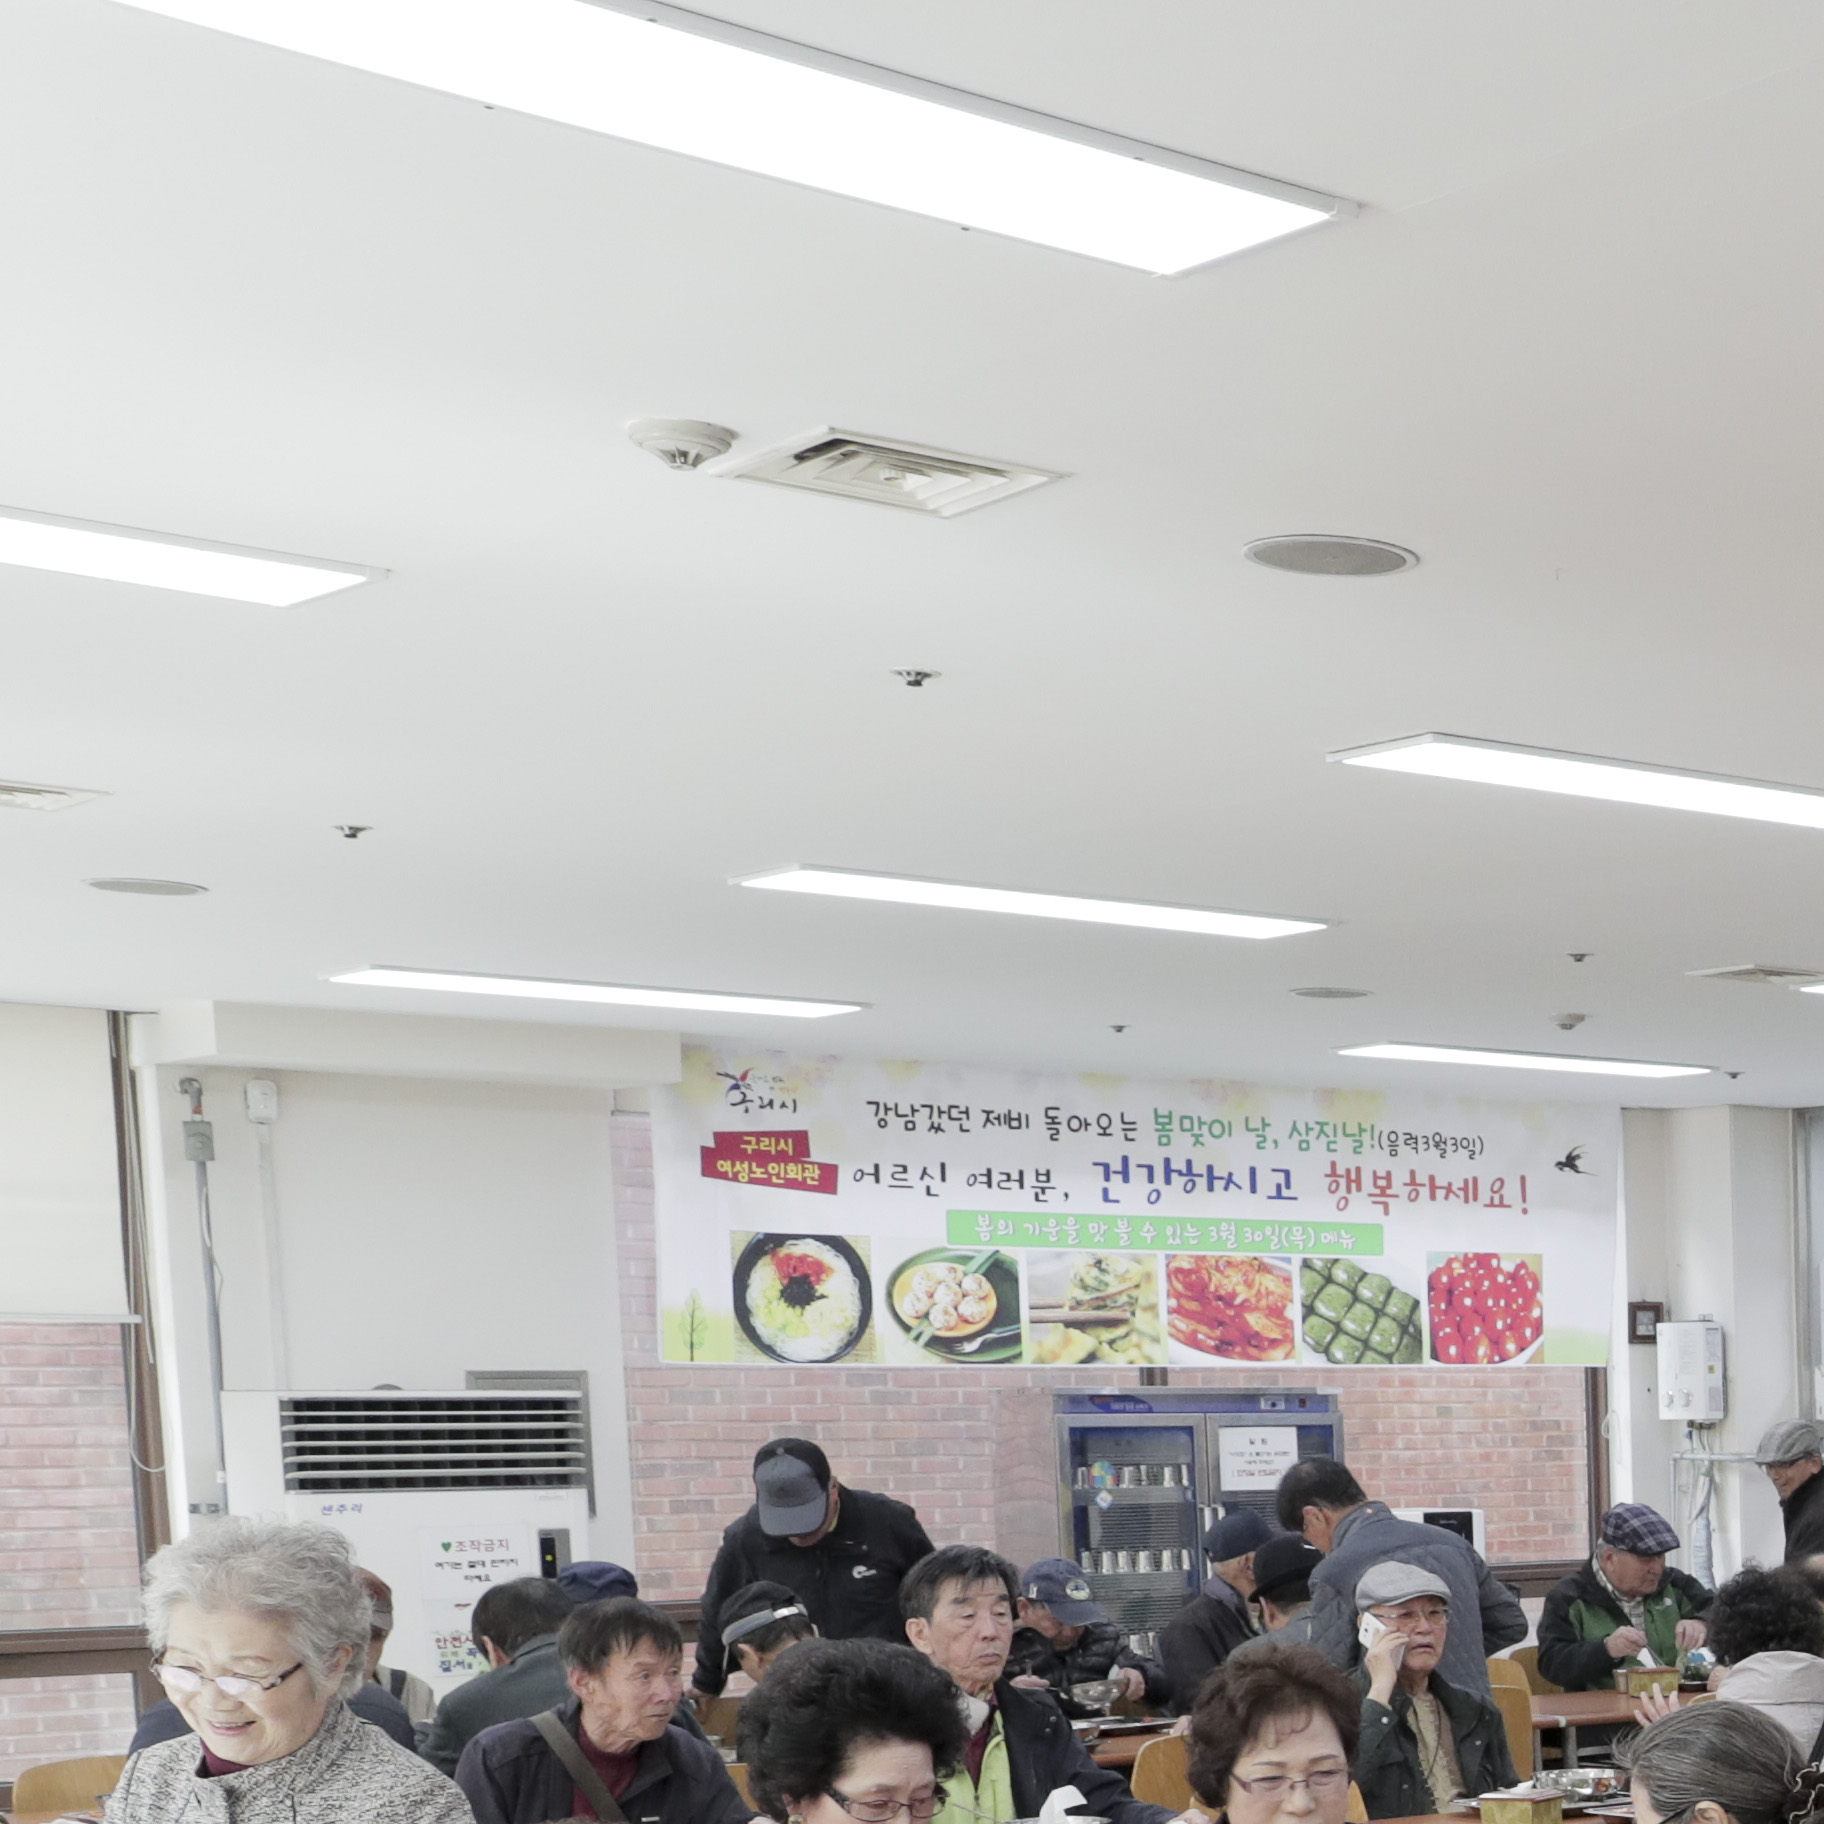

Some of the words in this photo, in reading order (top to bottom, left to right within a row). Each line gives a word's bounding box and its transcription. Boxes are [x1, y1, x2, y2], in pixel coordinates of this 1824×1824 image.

[730, 1091, 797, 1113] 구리시
[866, 1101, 970, 1134] 강남갔던
[981, 1107, 1030, 1130] 제비
[1044, 1107, 1138, 1141] 돌아오는
[1153, 1108, 1233, 1147] 봄맞이
[1245, 1117, 1279, 1150] 날,
[740, 1136, 793, 1155] 구리시
[716, 1160, 821, 1185] 여성노인회관
[853, 1162, 946, 1197] 어르신
[966, 1168, 1069, 1202] 여러분,
[1092, 1155, 1298, 1204] 건강하시고
[1324, 1160, 1529, 1216] 행복하세요!
[975, 1214, 1014, 1242] 봄의
[1024, 1216, 1081, 1245] 기운을
[1114, 1218, 1133, 1246] 볼
[1139, 1221, 1158, 1244] 수
[1165, 1222, 1202, 1247] 있는
[1208, 1222, 1238, 1249] 3월
[1243, 1223, 1316, 1251] 30일(목)
[1320, 1229, 1356, 1250] 메뉴
[321, 1503, 363, 1515] 센추리
[455, 1539, 509, 1552] 조작금지
